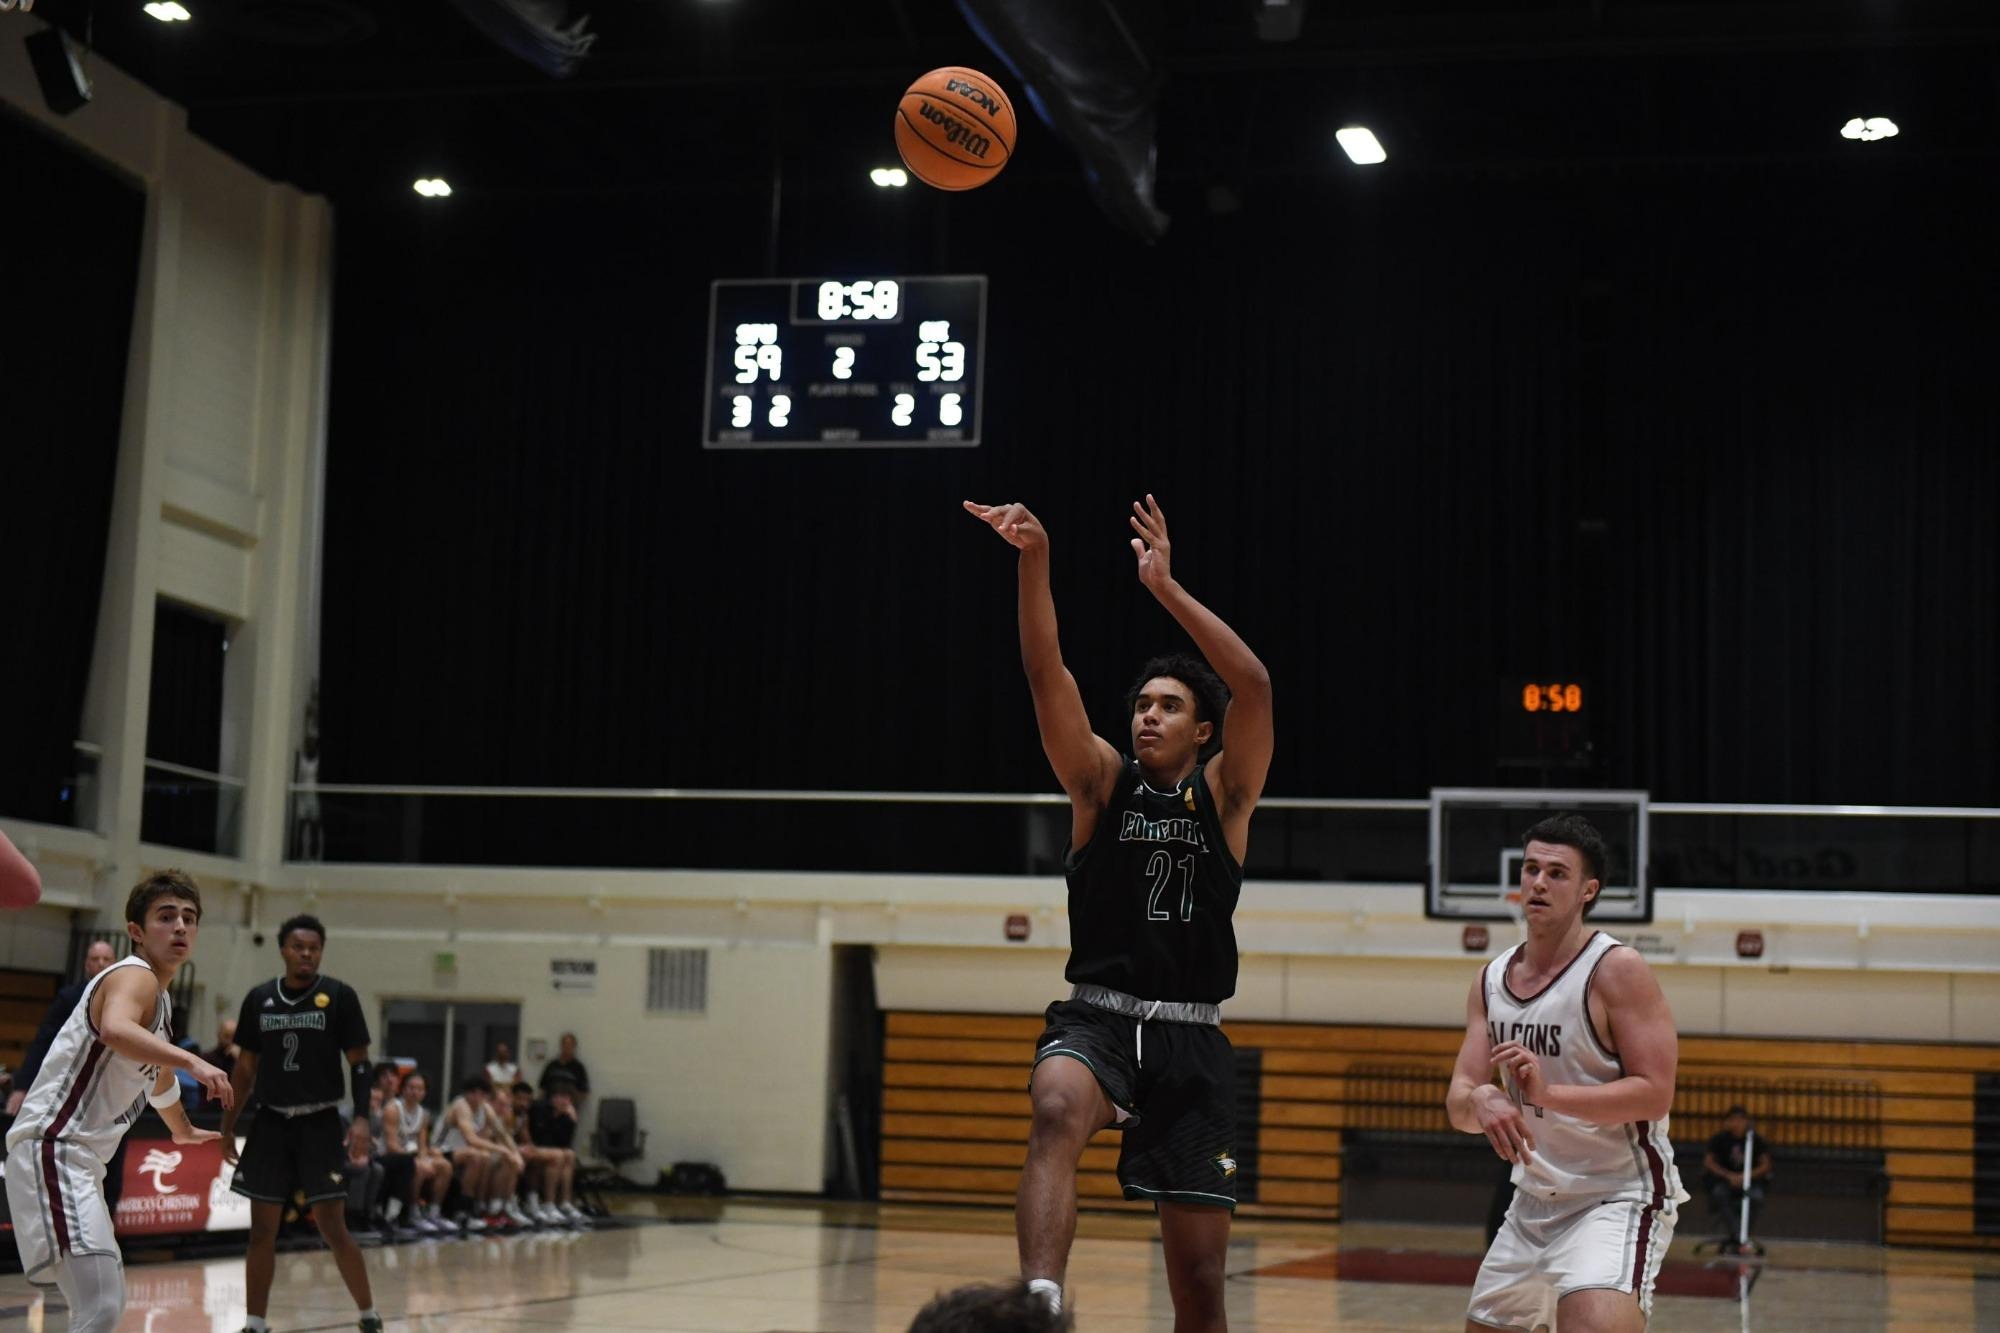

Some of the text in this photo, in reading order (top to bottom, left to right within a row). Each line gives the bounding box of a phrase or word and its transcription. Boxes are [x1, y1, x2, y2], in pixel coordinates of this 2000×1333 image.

[946, 79, 1000, 117] NCAA
[920, 102, 991, 159] Wilson
[818, 280, 899, 320] 8:58
[735, 344, 782, 384] 59
[832, 347, 855, 379] 2
[916, 342, 965, 381] 53
[732, 395, 752, 427] 3
[769, 395, 791, 427] 2
[892, 393, 915, 426] 2
[940, 393, 962, 426] 6
[1523, 684, 1582, 712] 8:58
[1119, 811, 1210, 853] CONCOR
[1145, 850, 1196, 922] 21
[282, 1032, 300, 1071] 2
[1488, 1021, 1562, 1057] ALCONS
